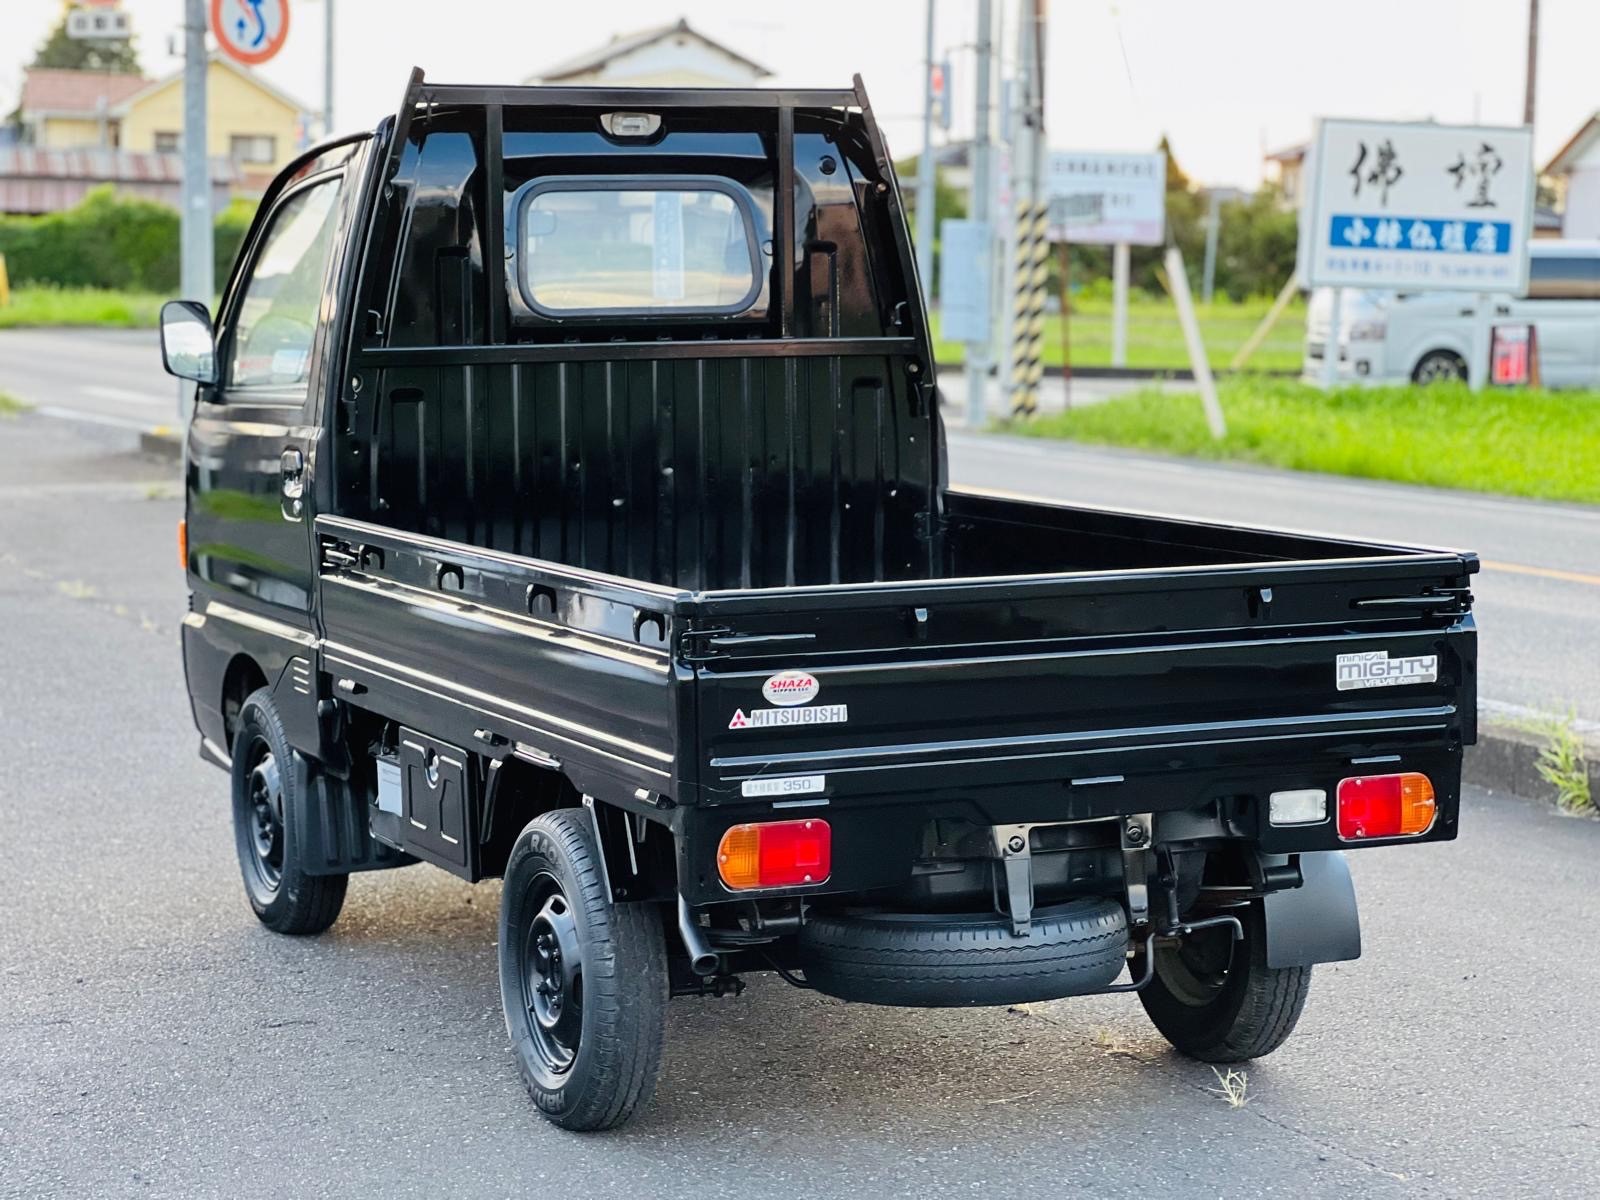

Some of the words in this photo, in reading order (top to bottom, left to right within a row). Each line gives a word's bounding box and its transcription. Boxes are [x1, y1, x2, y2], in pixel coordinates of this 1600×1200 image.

[1338, 657, 1435, 680] MIGHTY
[770, 678, 812, 688] SHAZA
[751, 707, 846, 726] MITSUBISHI
[783, 779, 811, 791] 350
